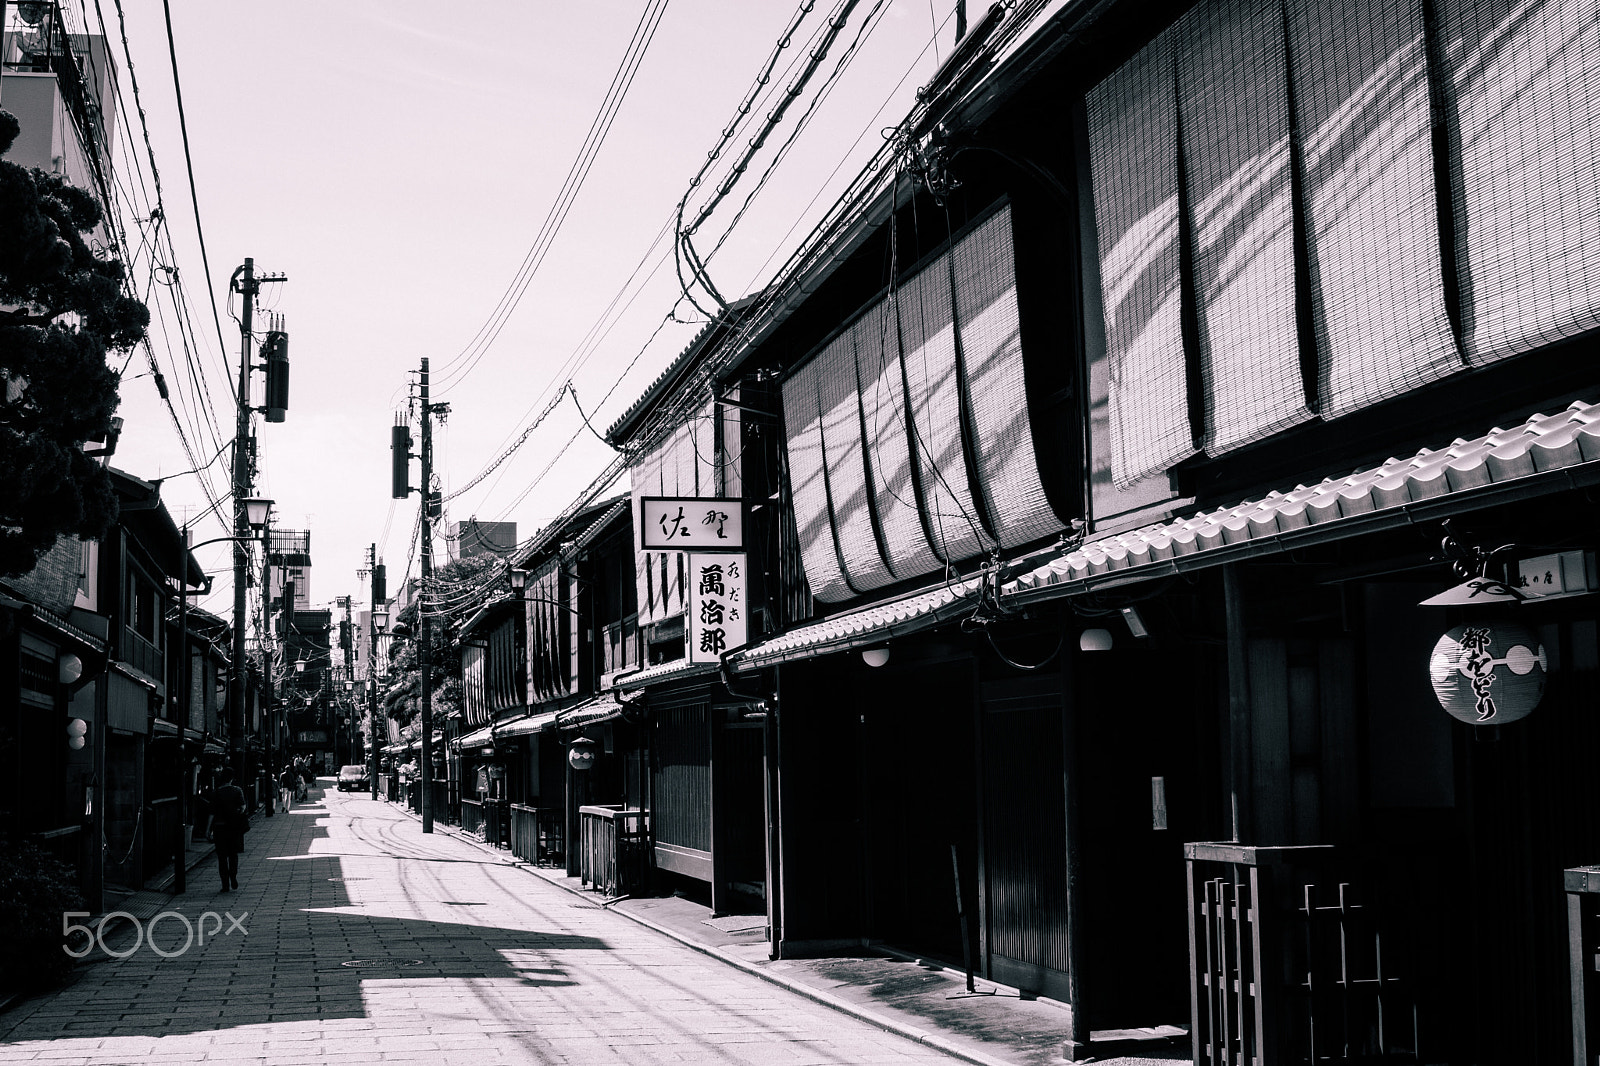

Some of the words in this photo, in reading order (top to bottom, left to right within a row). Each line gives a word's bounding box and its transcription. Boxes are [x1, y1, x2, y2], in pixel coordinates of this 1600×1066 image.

[659, 506, 729, 541] 佐野
[699, 563, 727, 657] 萬治郎
[1460, 626, 1497, 722] 都をどり
